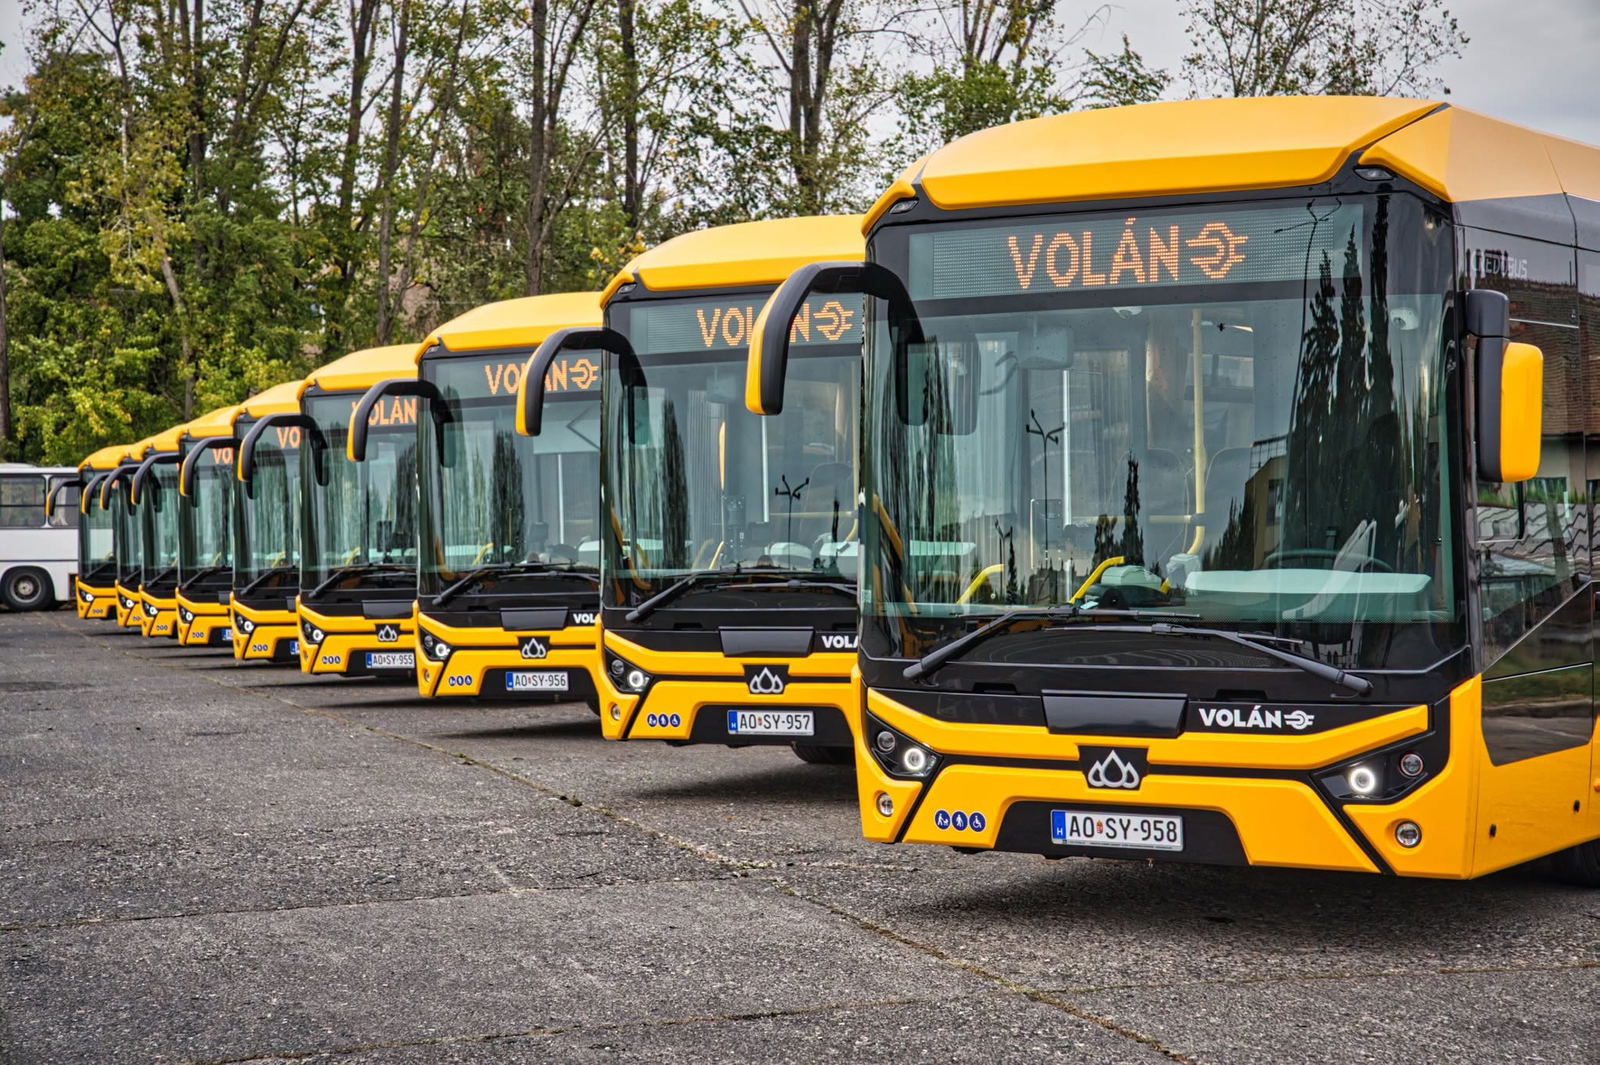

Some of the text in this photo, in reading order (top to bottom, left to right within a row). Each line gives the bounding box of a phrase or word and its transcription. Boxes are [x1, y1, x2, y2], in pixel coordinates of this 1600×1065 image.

[1007, 217, 1180, 290] VOLÁN
[515, 674, 567, 688] AO SY-956
[740, 714, 811, 731] AO SY-957
[1198, 704, 1282, 729] VOLÁN
[1056, 827, 1064, 836] H
[1069, 815, 1178, 843] AO SY-958
